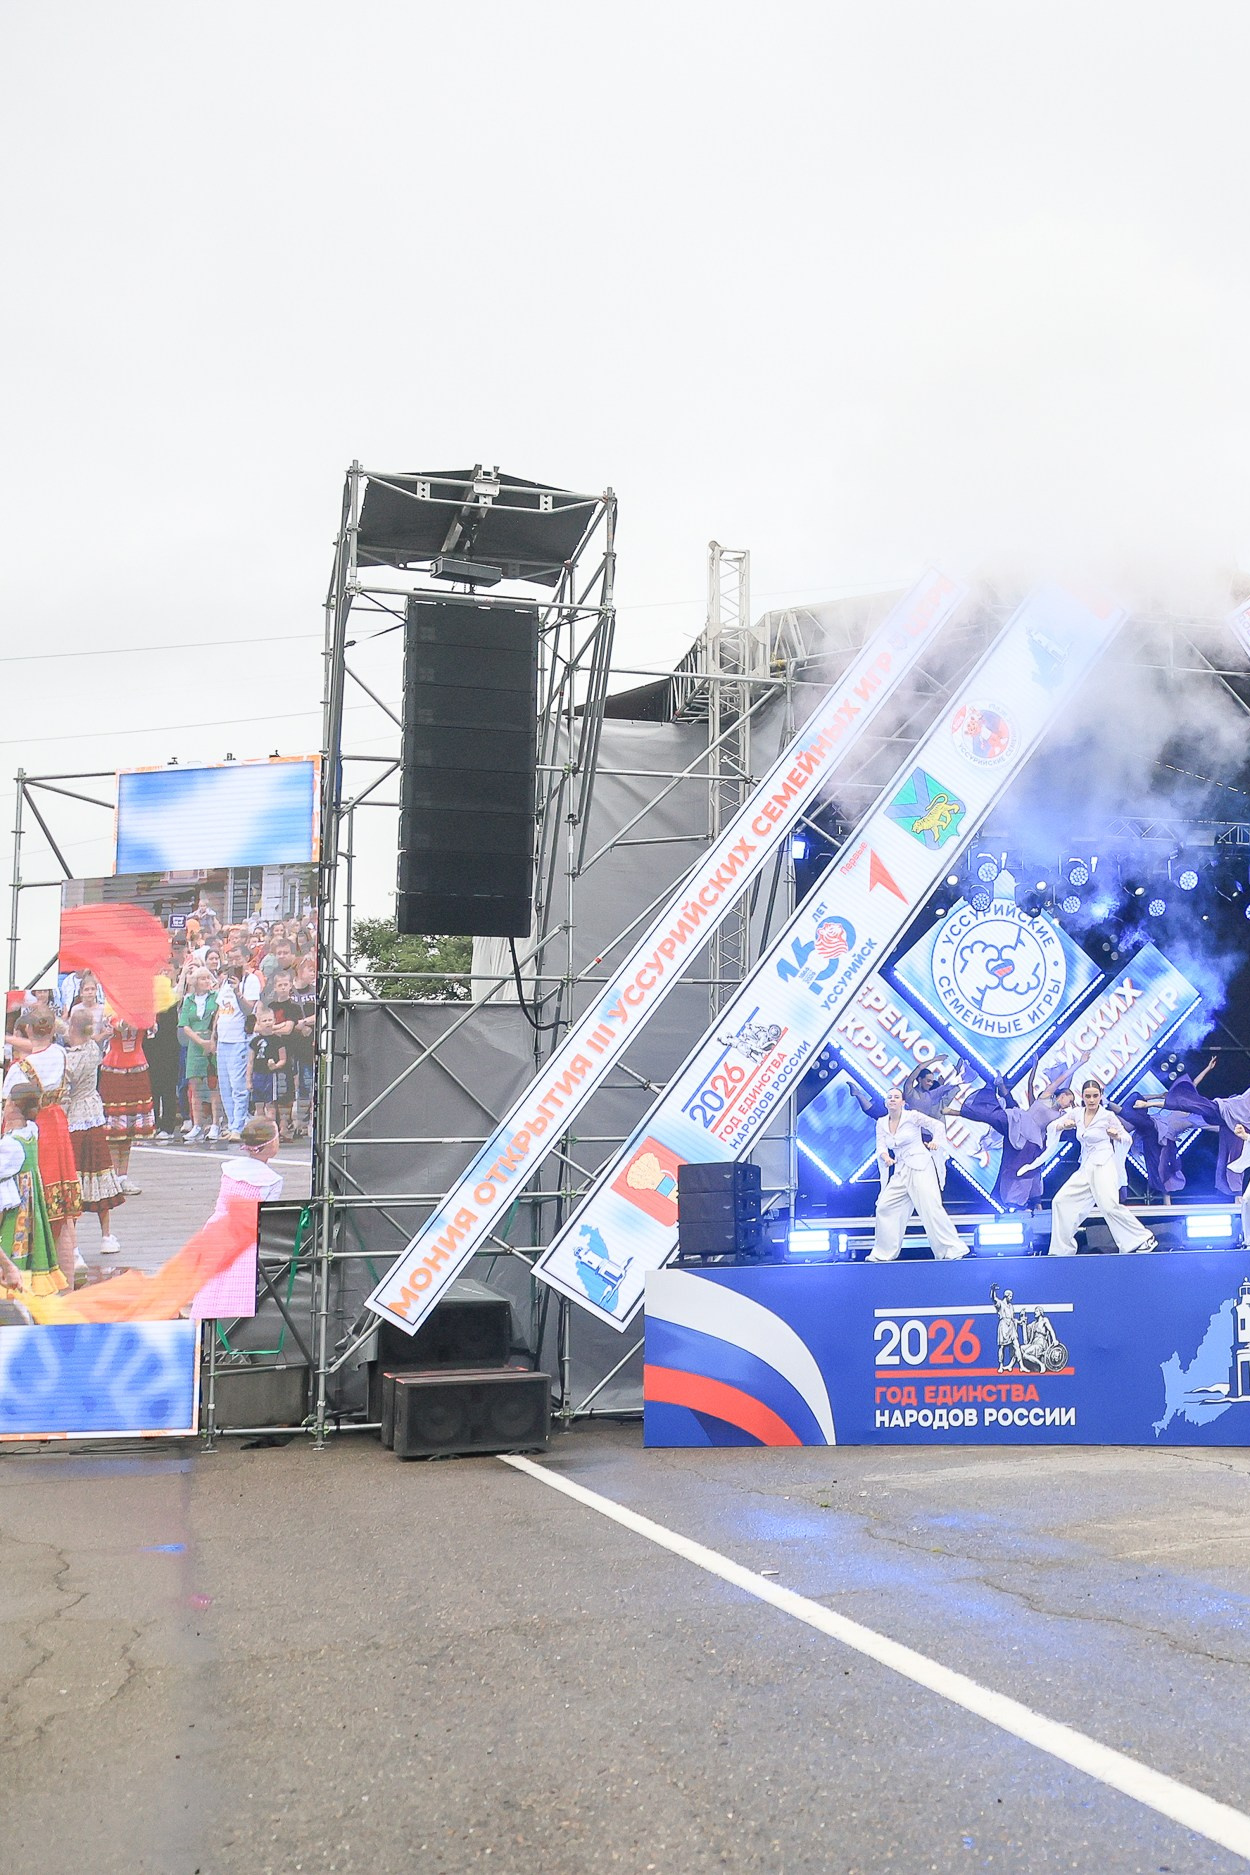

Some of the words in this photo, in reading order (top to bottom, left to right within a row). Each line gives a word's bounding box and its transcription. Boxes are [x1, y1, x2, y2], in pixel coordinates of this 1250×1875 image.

[840, 841, 868, 875] Первые
[811, 901, 828, 922] ЛЕТ
[942, 903, 1054, 948] УССУРИЙСКИЕ
[388, 1207, 478, 1317] МОНИЯ
[473, 1054, 593, 1205] ОТКРЫТИЯ
[586, 1024, 616, 1053] III
[608, 836, 757, 1024] УССУРИЙСКИХ
[751, 699, 862, 836] СЕМЕЙНЫХ
[853, 652, 892, 702] ИГР
[821, 938, 878, 1010] УССУРИЙСК
[938, 976, 1023, 1033] СЕМЕЙНЫЕ
[1028, 978, 1061, 1024] ИГРЫ
[1136, 985, 1179, 1042] ИГР
[689, 1062, 745, 1129] 2026
[718, 1116, 742, 1142] ГОД
[738, 1052, 788, 1115] ЕДИНСТВА
[729, 1091, 775, 1150] НАРОДОВ
[772, 1040, 811, 1092] РОССИИ
[873, 1319, 981, 1366] 2026
[875, 1386, 918, 1406] ГОД
[924, 1384, 1040, 1405] ЕДИНСТВА
[875, 1409, 978, 1430] НАРОДОВ
[983, 1407, 1076, 1427] РОССИИ
